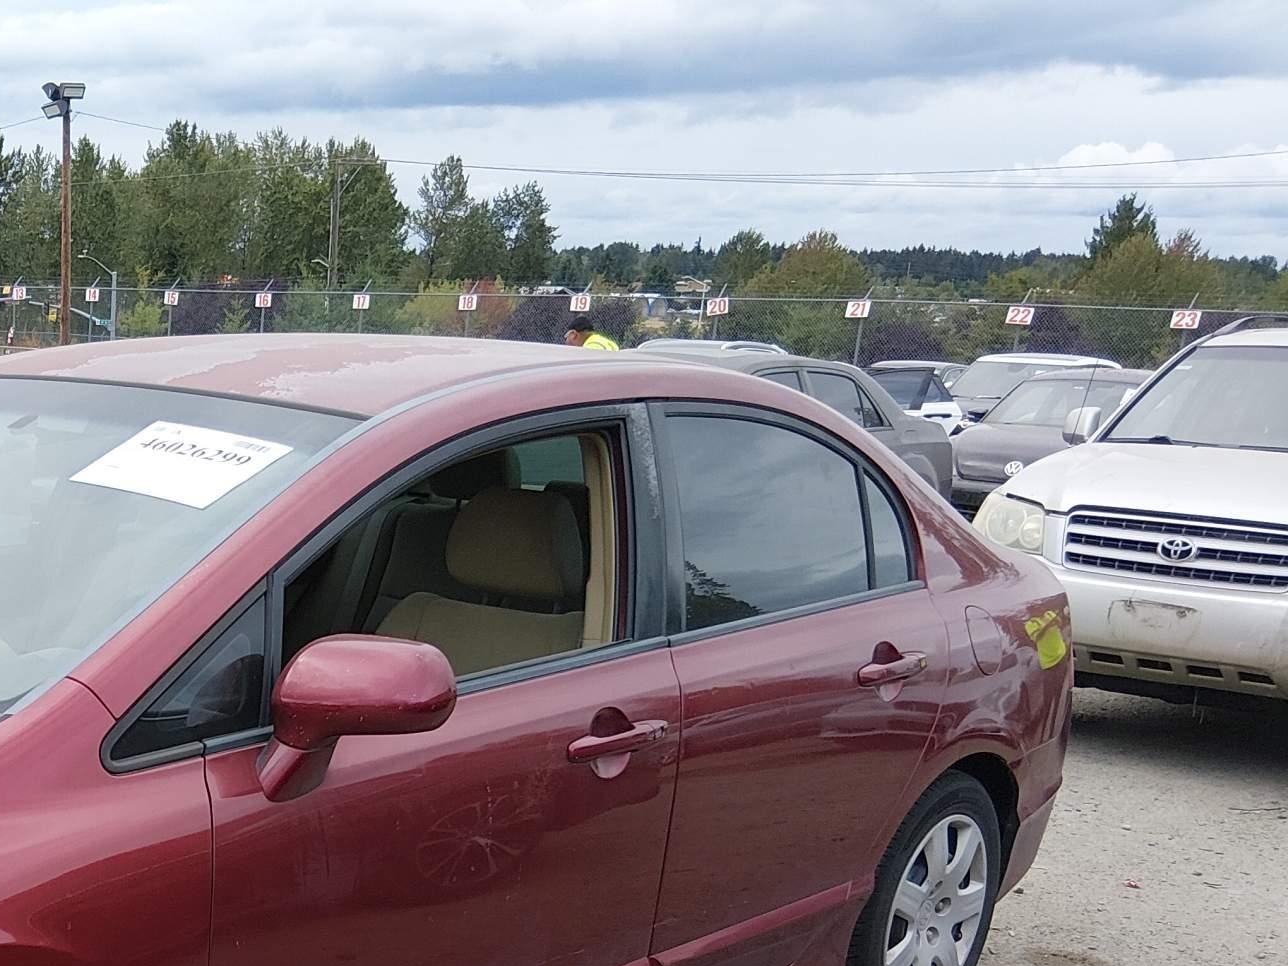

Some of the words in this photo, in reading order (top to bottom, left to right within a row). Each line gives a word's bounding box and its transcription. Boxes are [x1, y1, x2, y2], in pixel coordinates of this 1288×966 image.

[15, 288, 24, 299] 13
[88, 289, 98, 301] 14
[167, 292, 177, 305] 15
[258, 294, 269, 306] 16
[356, 295, 367, 308] 17
[462, 295, 474, 309] 18
[574, 296, 588, 310] 19
[709, 299, 726, 314] 20
[849, 302, 866, 317] 21
[1009, 307, 1031, 323] 22
[1173, 311, 1198, 328] 23
[140, 438, 252, 466] 46026299
